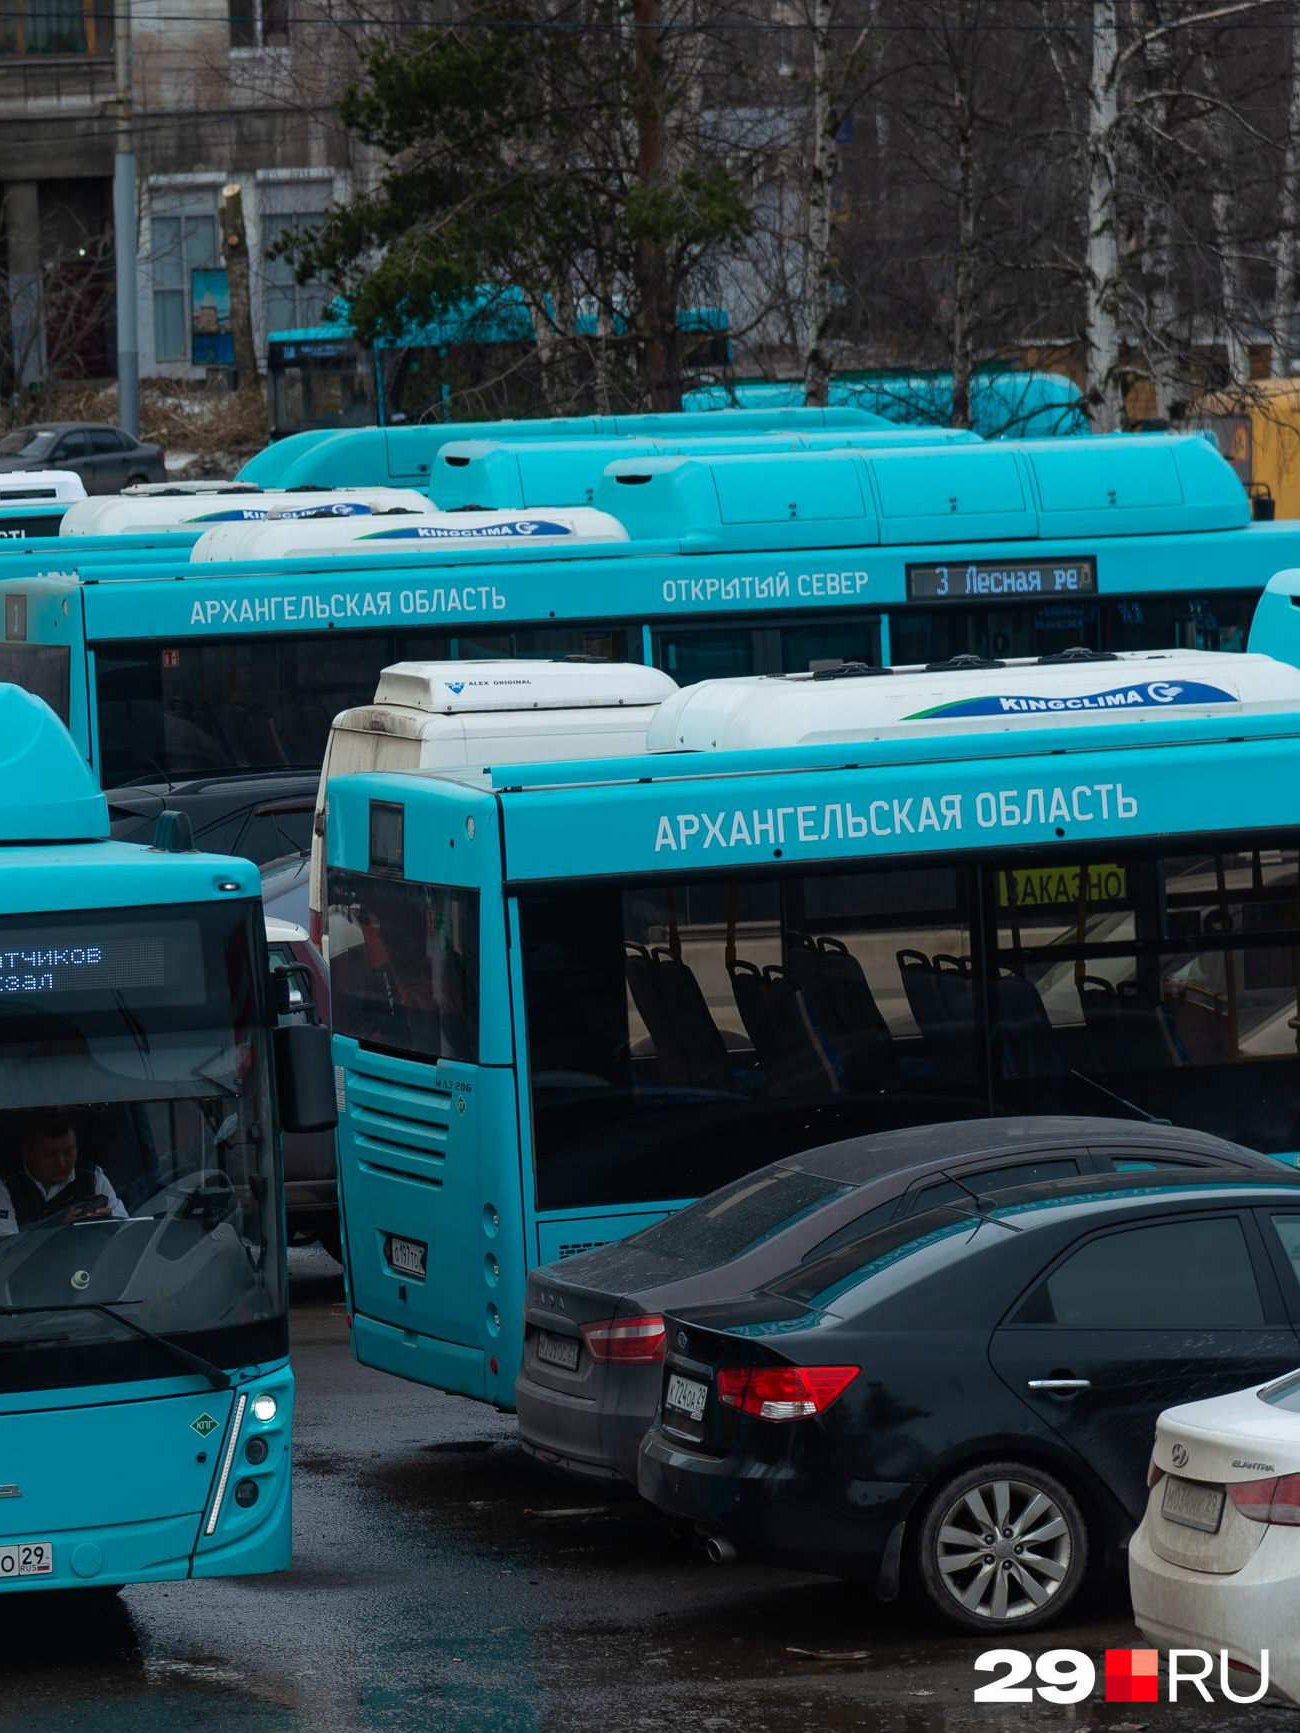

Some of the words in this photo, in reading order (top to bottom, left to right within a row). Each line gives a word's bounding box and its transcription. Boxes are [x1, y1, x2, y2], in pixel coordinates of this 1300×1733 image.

[418, 525, 512, 538] KINGCLIMA
[661, 572, 790, 603] ОТКРЫТЫЙ
[798, 571, 869, 597] СЕВЕР
[936, 567, 949, 596] 3
[965, 566, 1041, 595] Лесная
[189, 591, 392, 624] АРХАНГЕЛЬСКАЯ
[400, 586, 506, 614] ОБЛАСТЬ
[999, 689, 1144, 711] KINGCLIMA
[654, 794, 963, 851] АРХАНГЕЛЬСКАЯ
[976, 783, 1138, 828] ОБЛАСТЬ
[455, 1081, 472, 1093] 206
[697, 1387, 706, 1406] 29
[196, 1420, 214, 1430] КПГ
[1231, 1459, 1276, 1473] ELANTRA
[22, 1546, 44, 1565] 29
[20, 1564, 37, 1572] RUS
